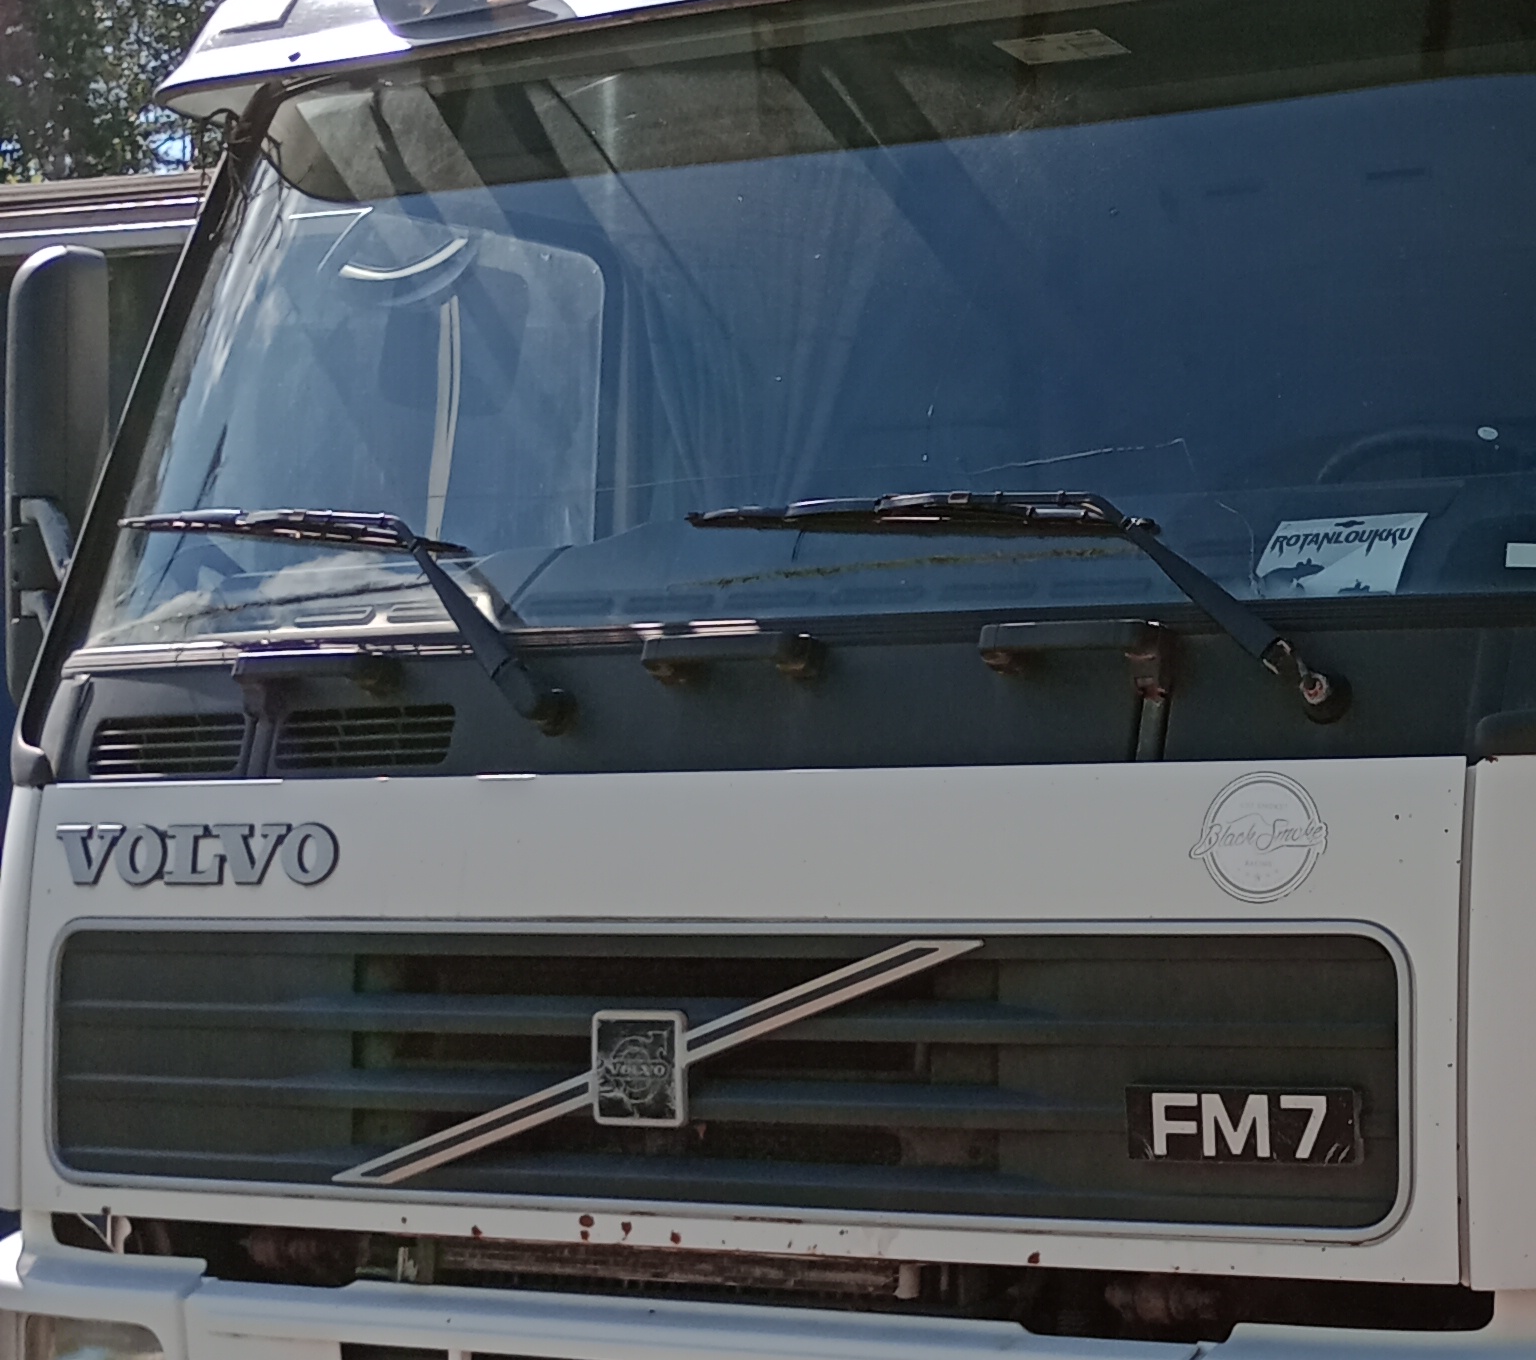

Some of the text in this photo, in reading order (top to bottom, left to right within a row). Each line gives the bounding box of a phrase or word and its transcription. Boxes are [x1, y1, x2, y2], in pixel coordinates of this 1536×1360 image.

[1271, 527, 1415, 557] ROTANLOUKKU
[56, 822, 339, 886] VOLVO
[608, 1064, 666, 1077] VOLVO
